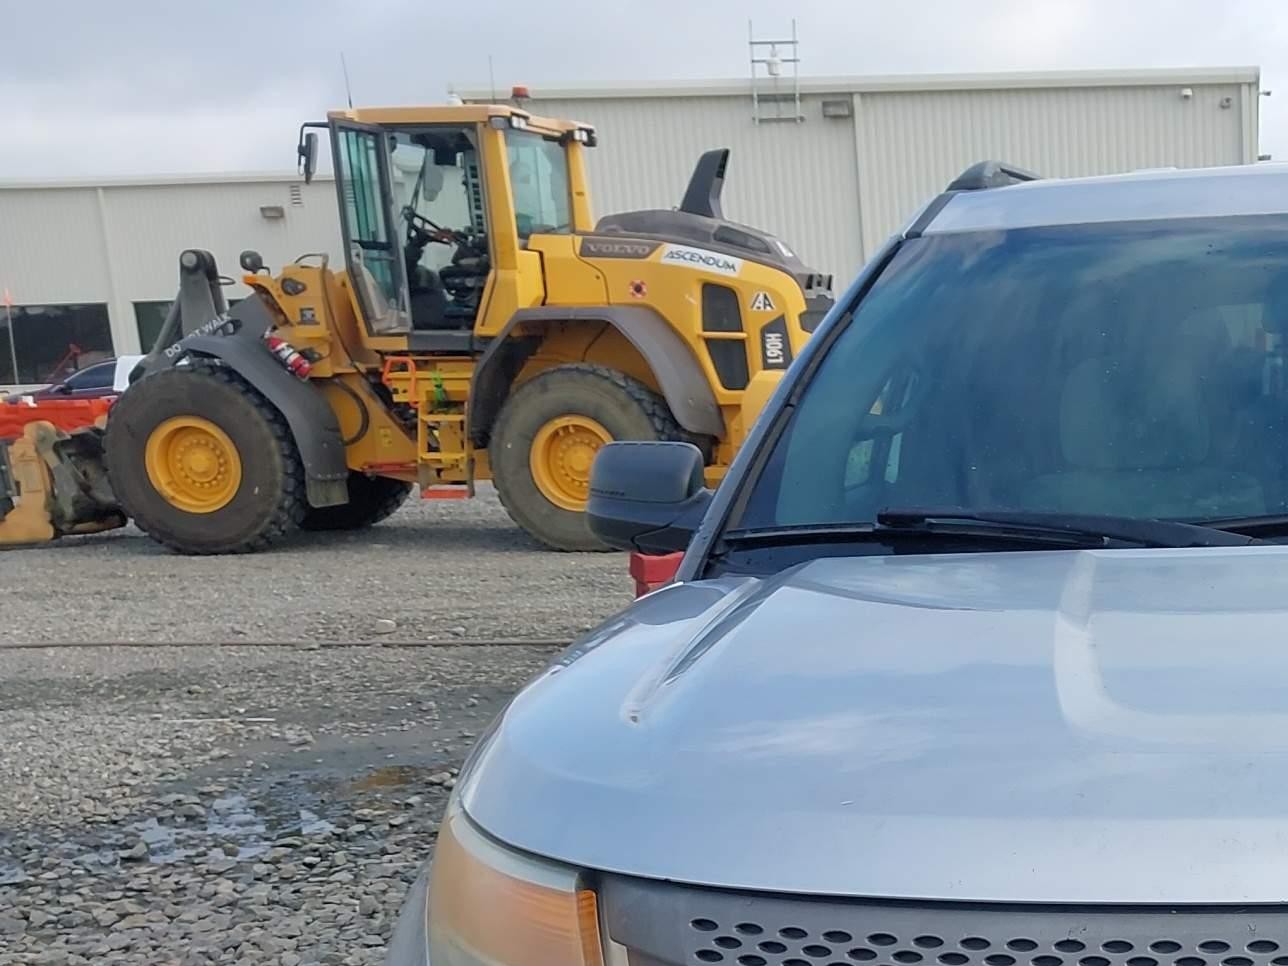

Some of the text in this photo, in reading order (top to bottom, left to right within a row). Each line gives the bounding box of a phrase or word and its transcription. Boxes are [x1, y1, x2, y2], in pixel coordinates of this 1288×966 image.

[588, 243, 650, 256] VOLVO
[664, 250, 736, 272] ASCENDUM
[163, 343, 181, 357] DO
[201, 312, 231, 333] WALK
[765, 332, 784, 364] L90H
